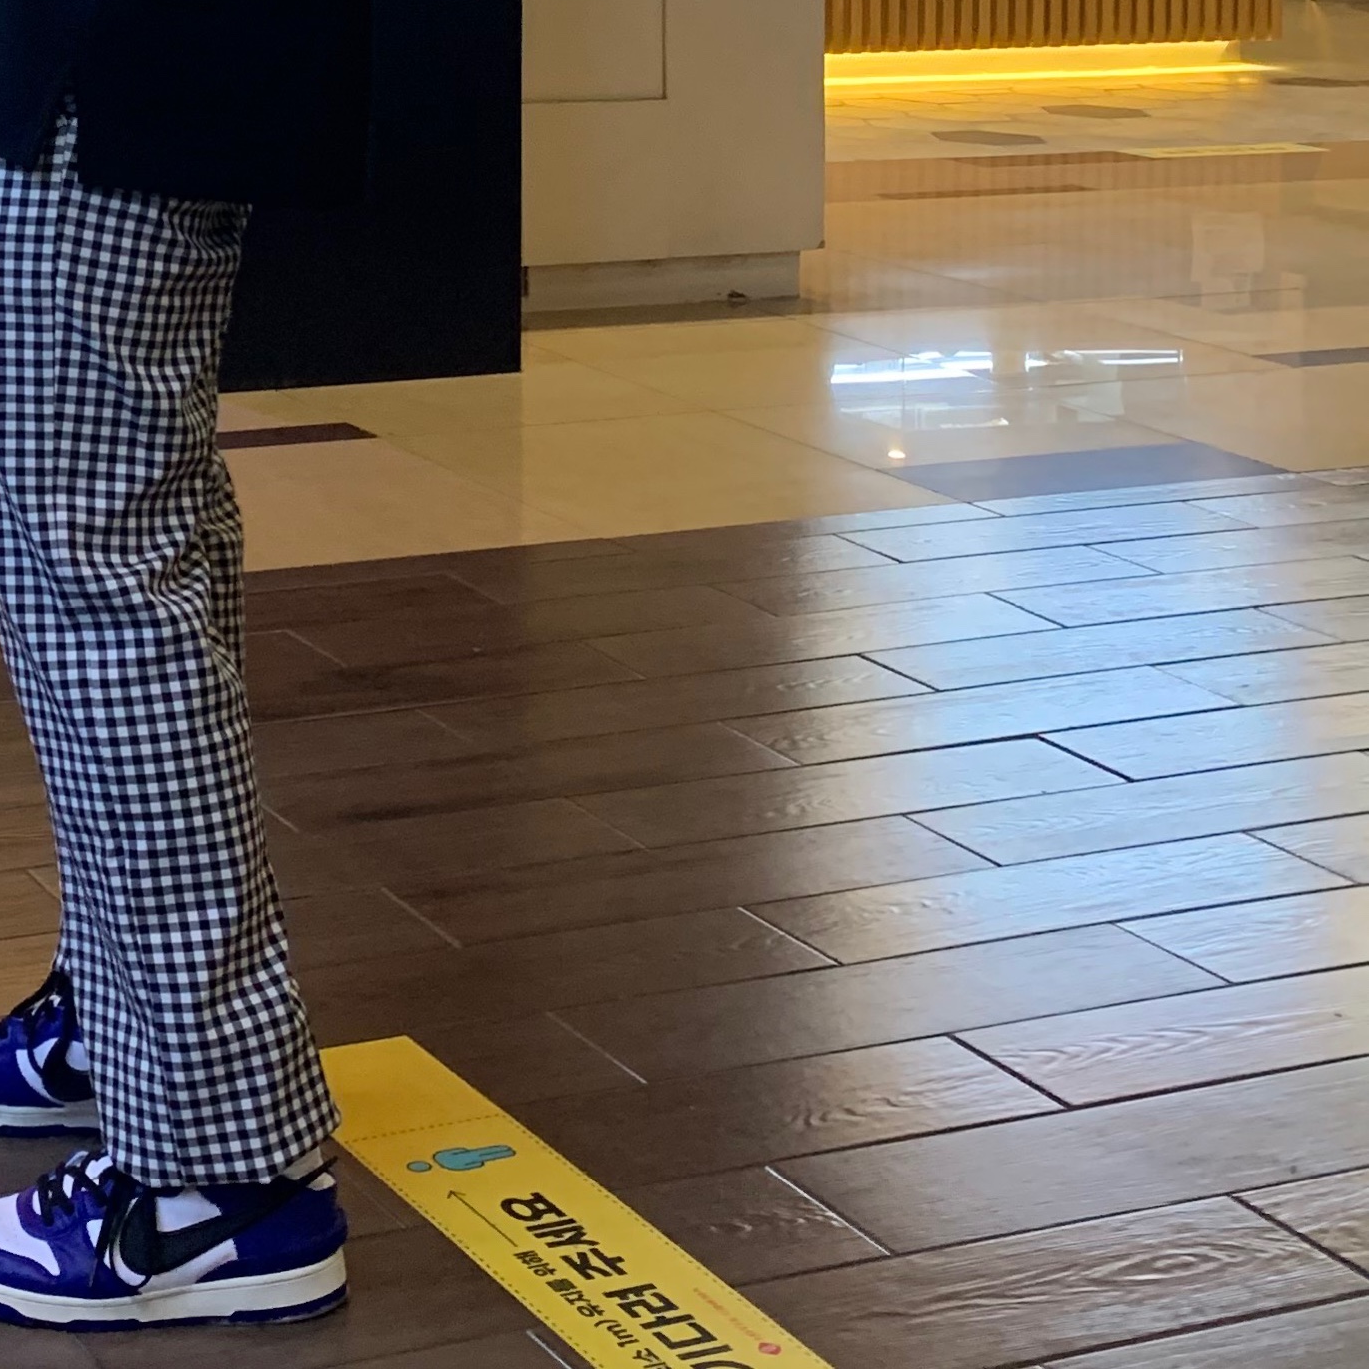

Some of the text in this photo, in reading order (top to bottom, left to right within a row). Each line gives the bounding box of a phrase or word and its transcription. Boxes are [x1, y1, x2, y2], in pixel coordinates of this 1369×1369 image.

[500, 1192, 628, 1281] 주세요
[512, 1249, 557, 1277] 위해
[545, 1278, 606, 1318] 유지를
